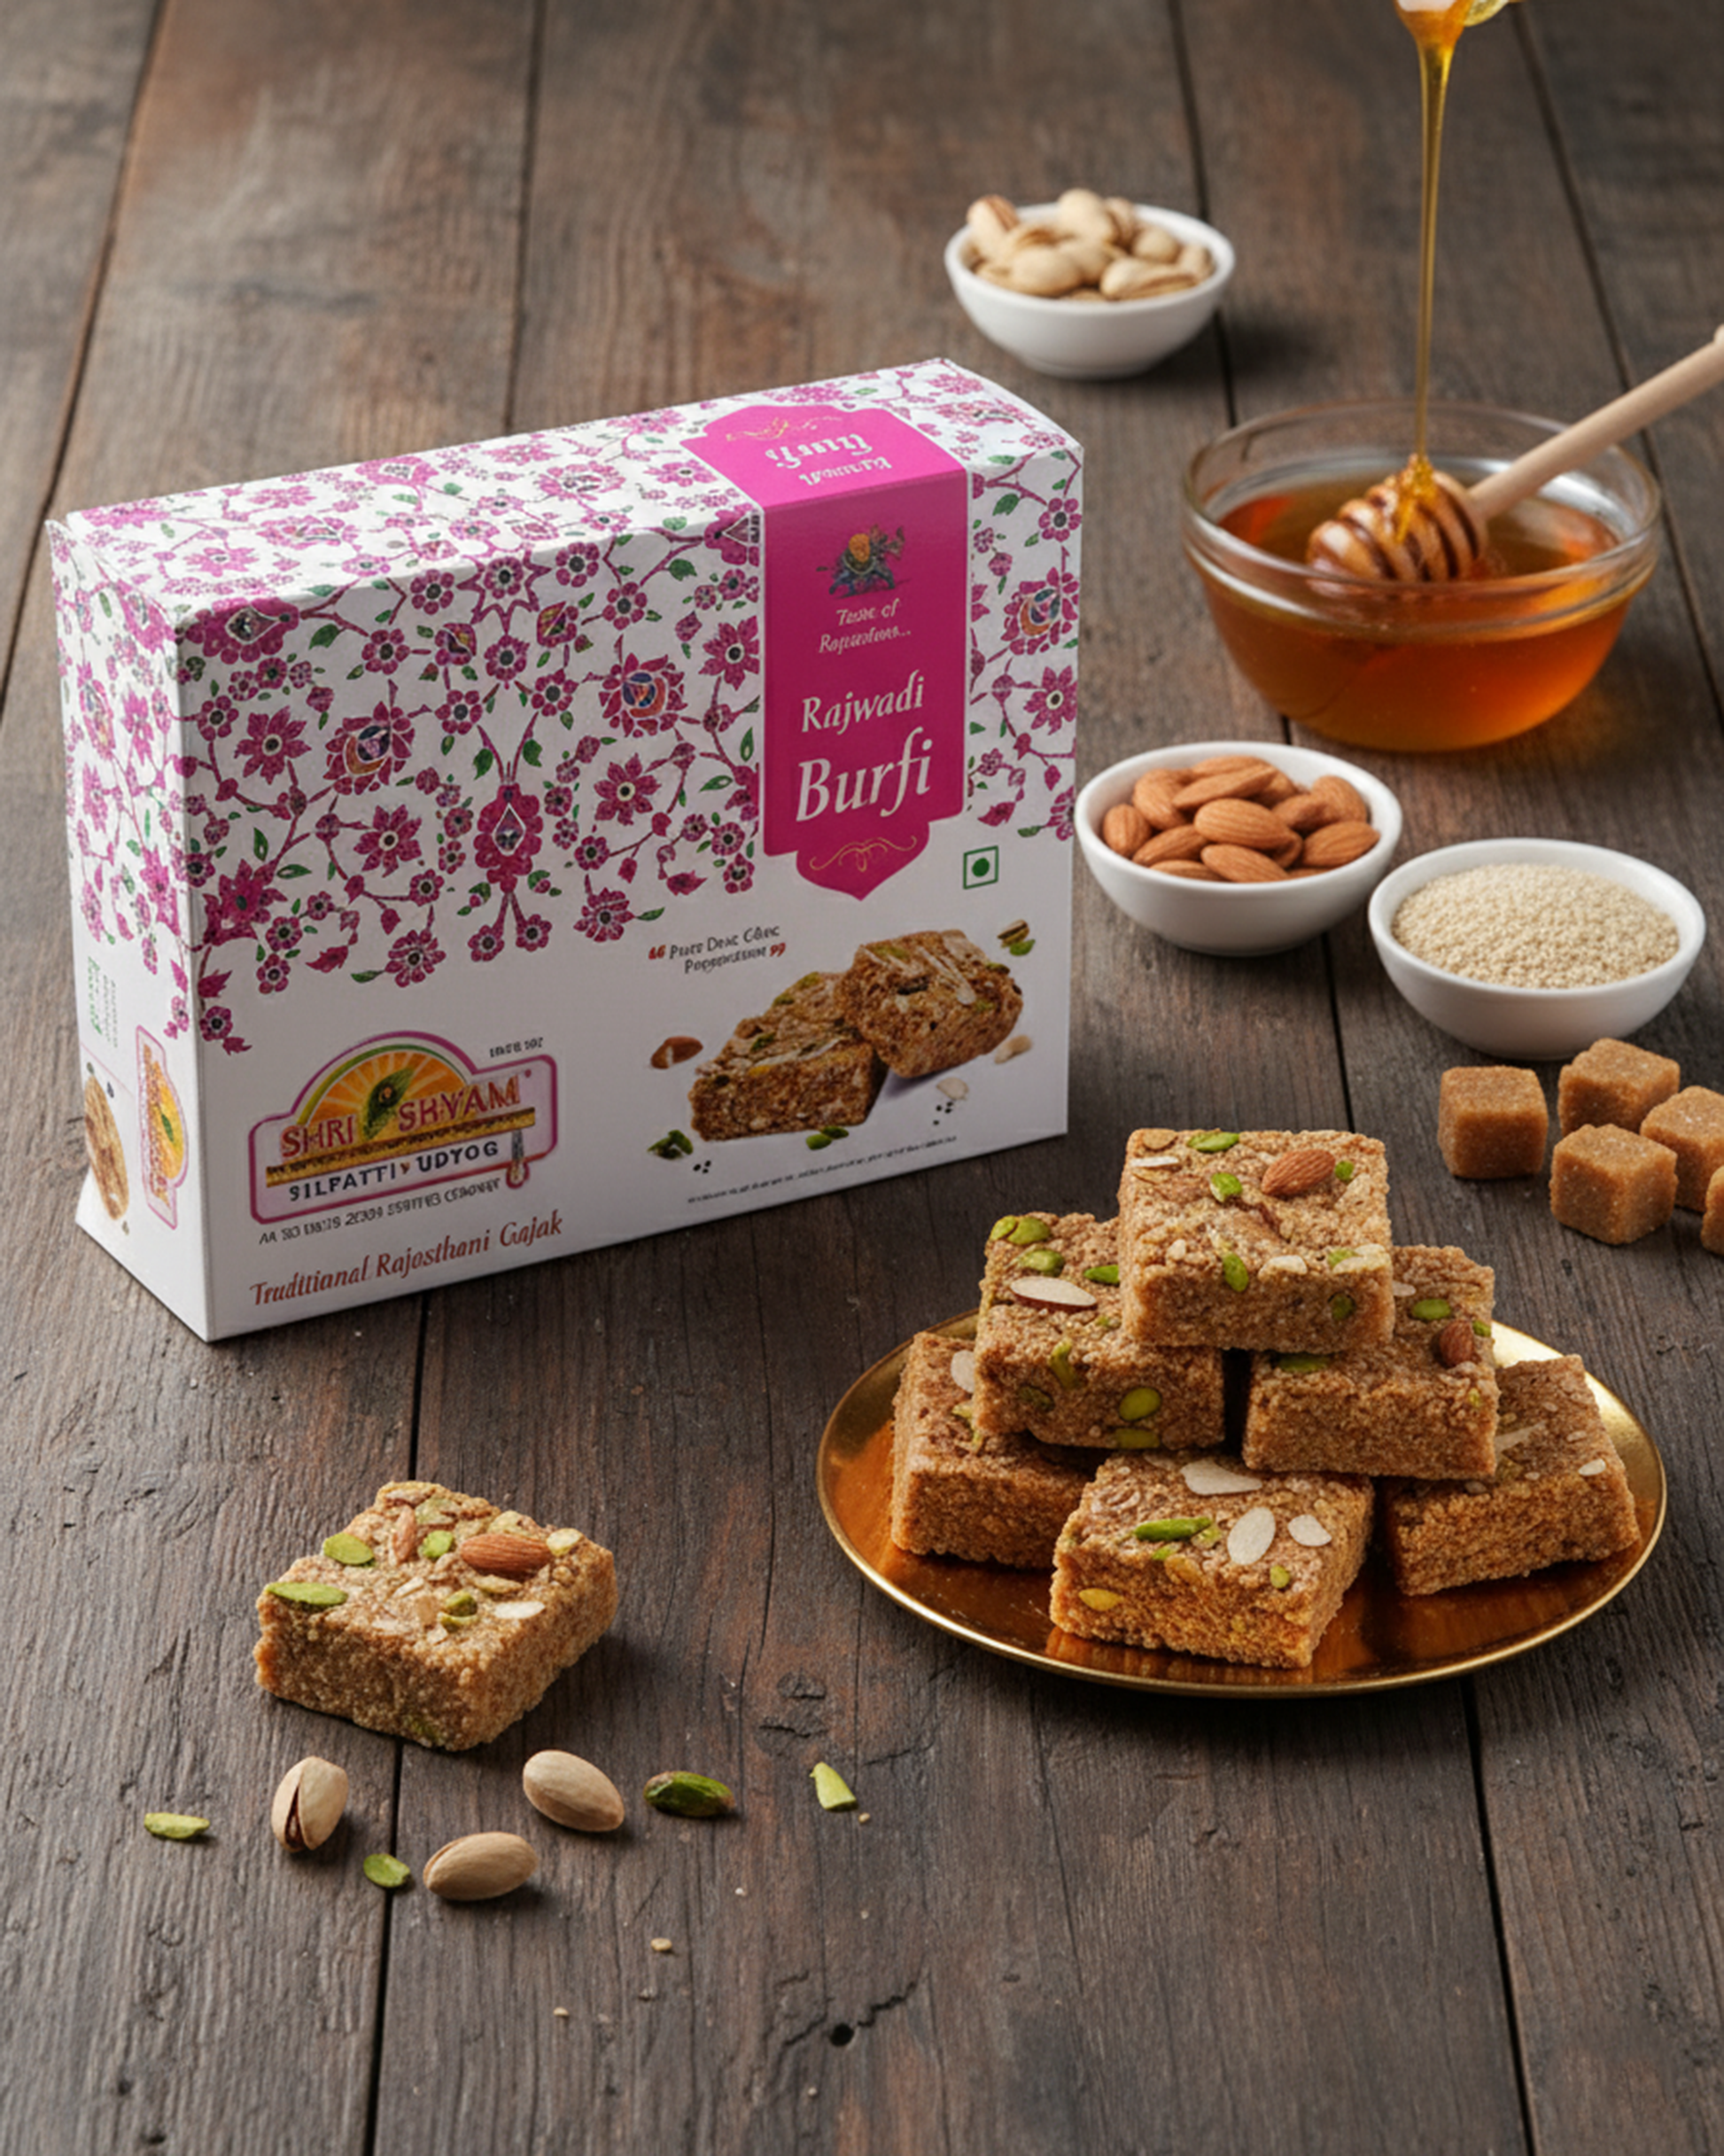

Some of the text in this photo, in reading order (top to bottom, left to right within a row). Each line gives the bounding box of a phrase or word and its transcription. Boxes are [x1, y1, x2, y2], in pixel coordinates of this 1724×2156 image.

[801, 670, 925, 736] Rajwadi
[796, 727, 933, 822] Burfi
[280, 1114, 356, 1158] SHRI
[415, 1141, 500, 1172] UDYOG
